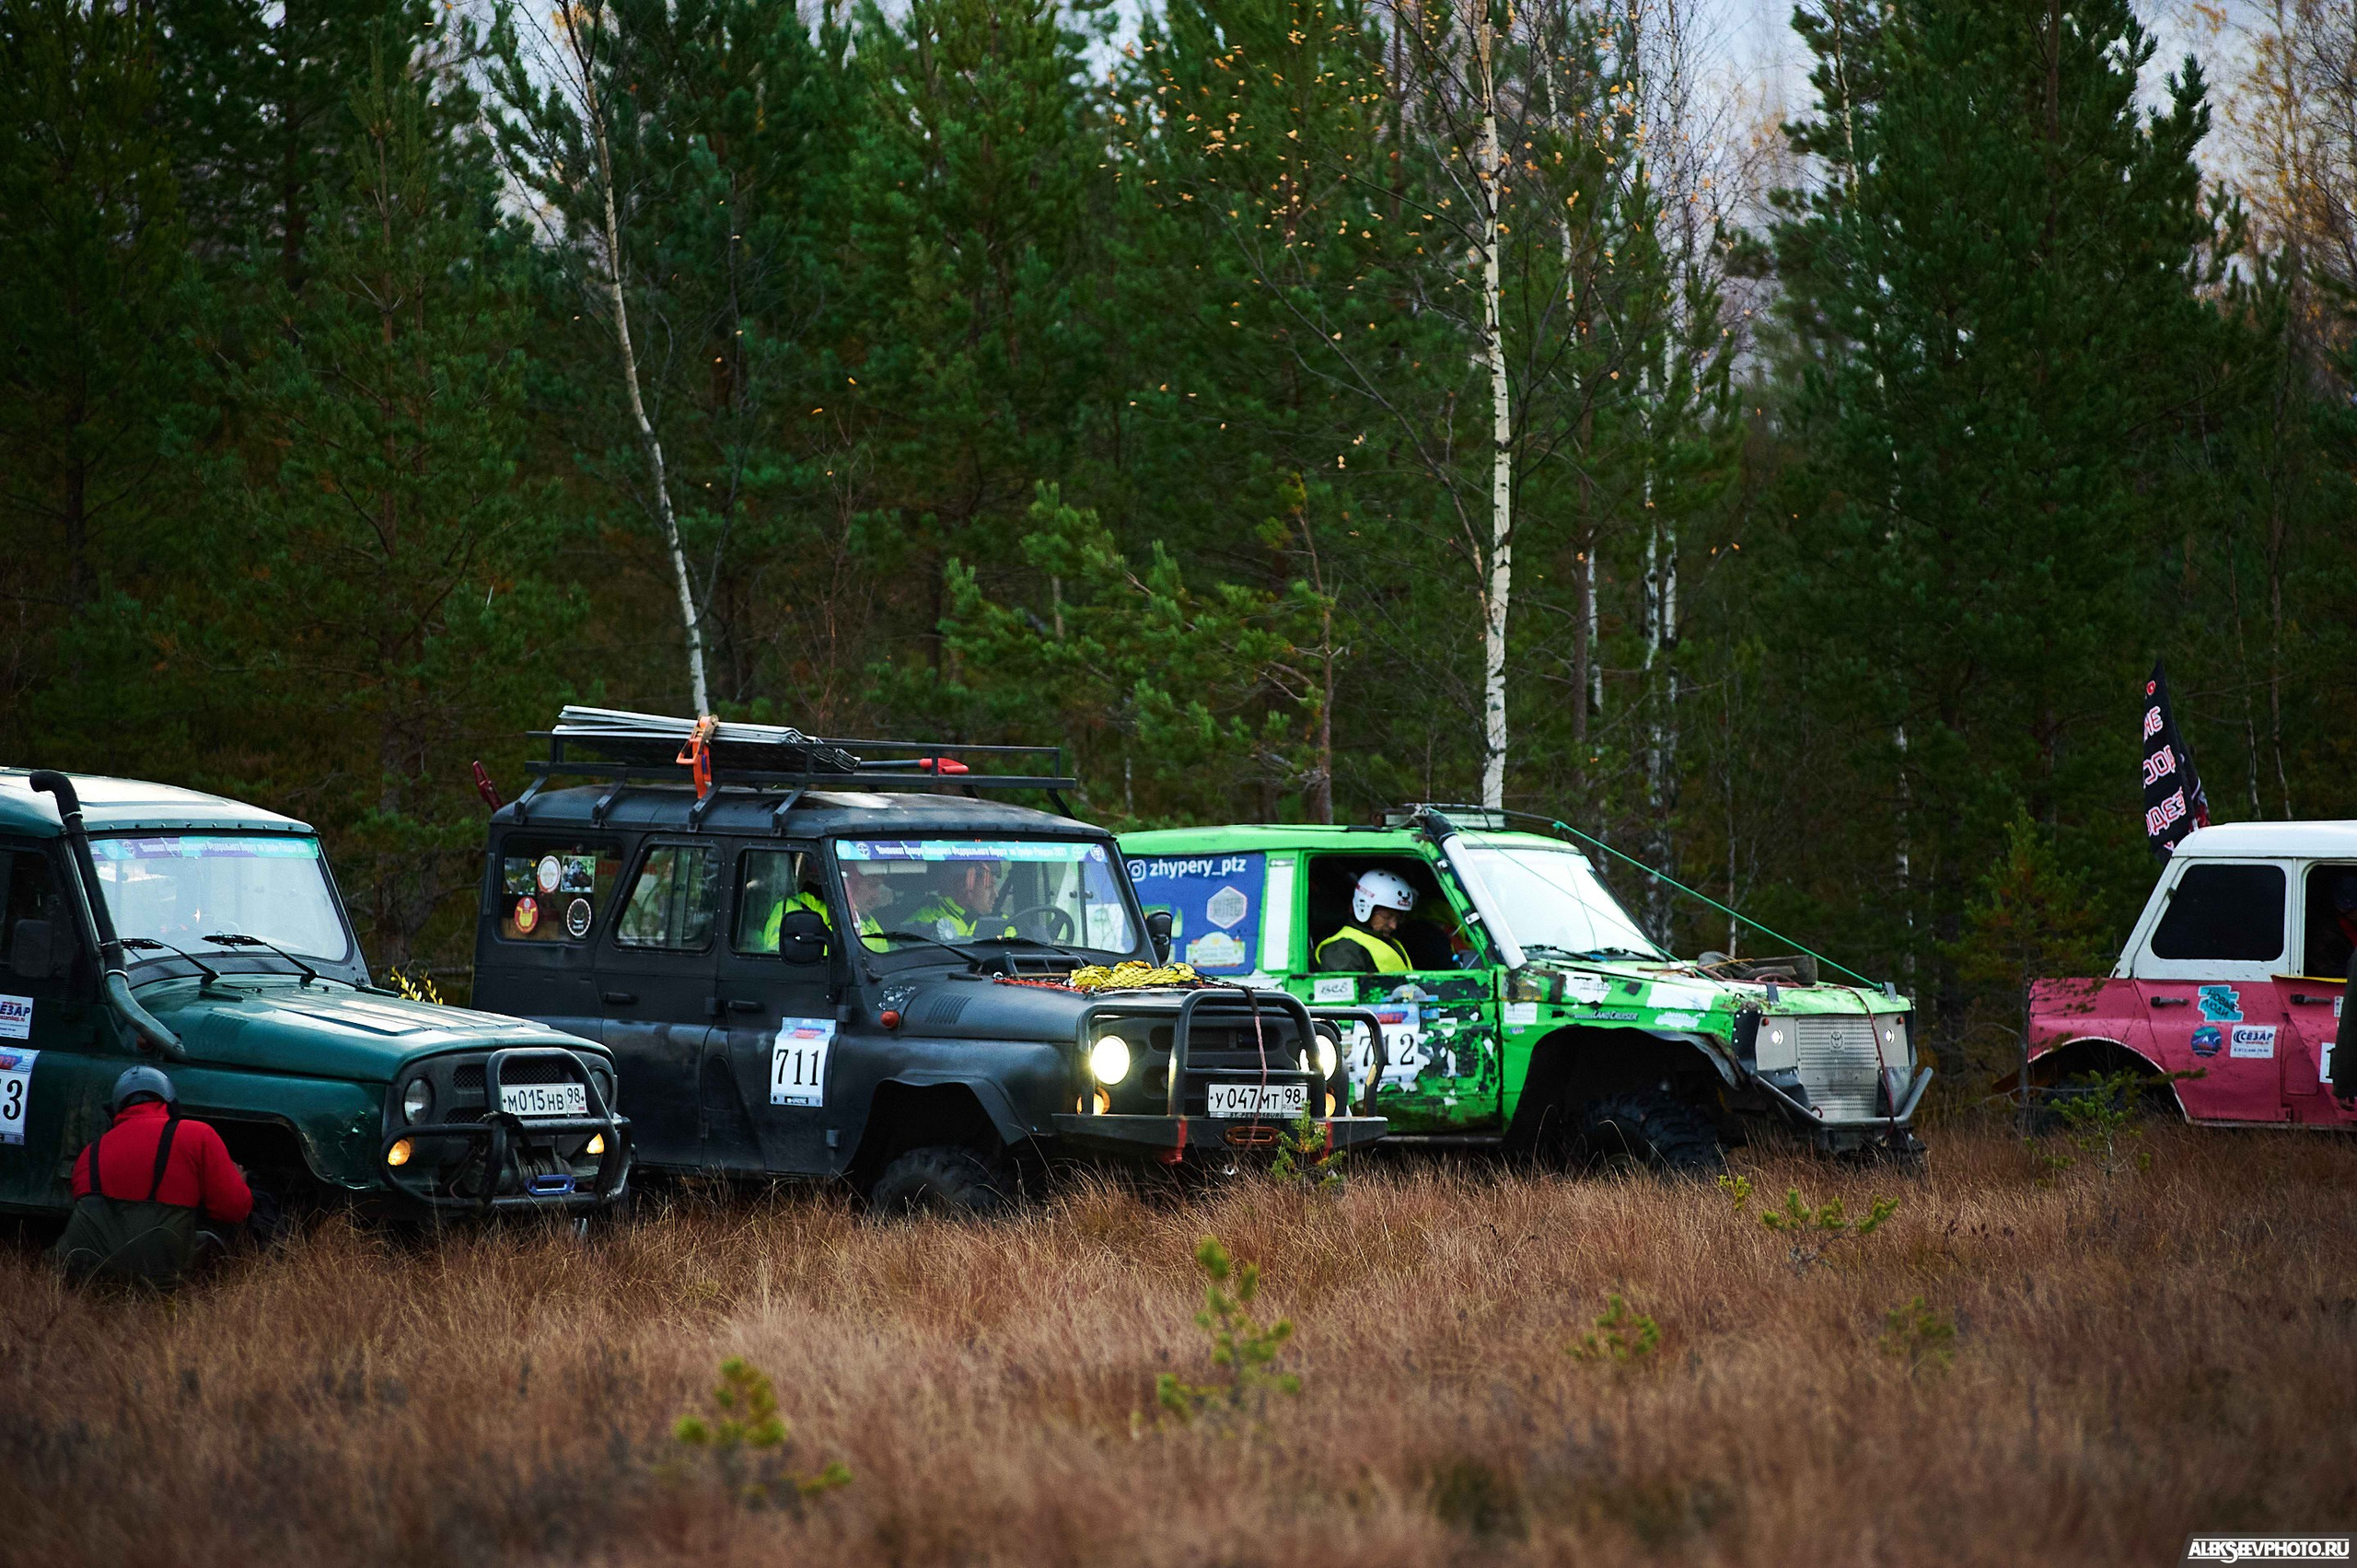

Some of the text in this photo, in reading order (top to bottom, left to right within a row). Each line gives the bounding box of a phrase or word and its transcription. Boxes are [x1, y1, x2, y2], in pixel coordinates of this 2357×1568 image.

[1149, 856, 1247, 879] zhypery_ptz
[0, 1005, 31, 1016] ЕЗАР
[2240, 1030, 2273, 1041] СЕЗАР
[775, 1049, 819, 1086] 711
[0, 1079, 23, 1121] 3
[567, 1087, 580, 1104] 98
[1284, 1088, 1301, 1104] 98
